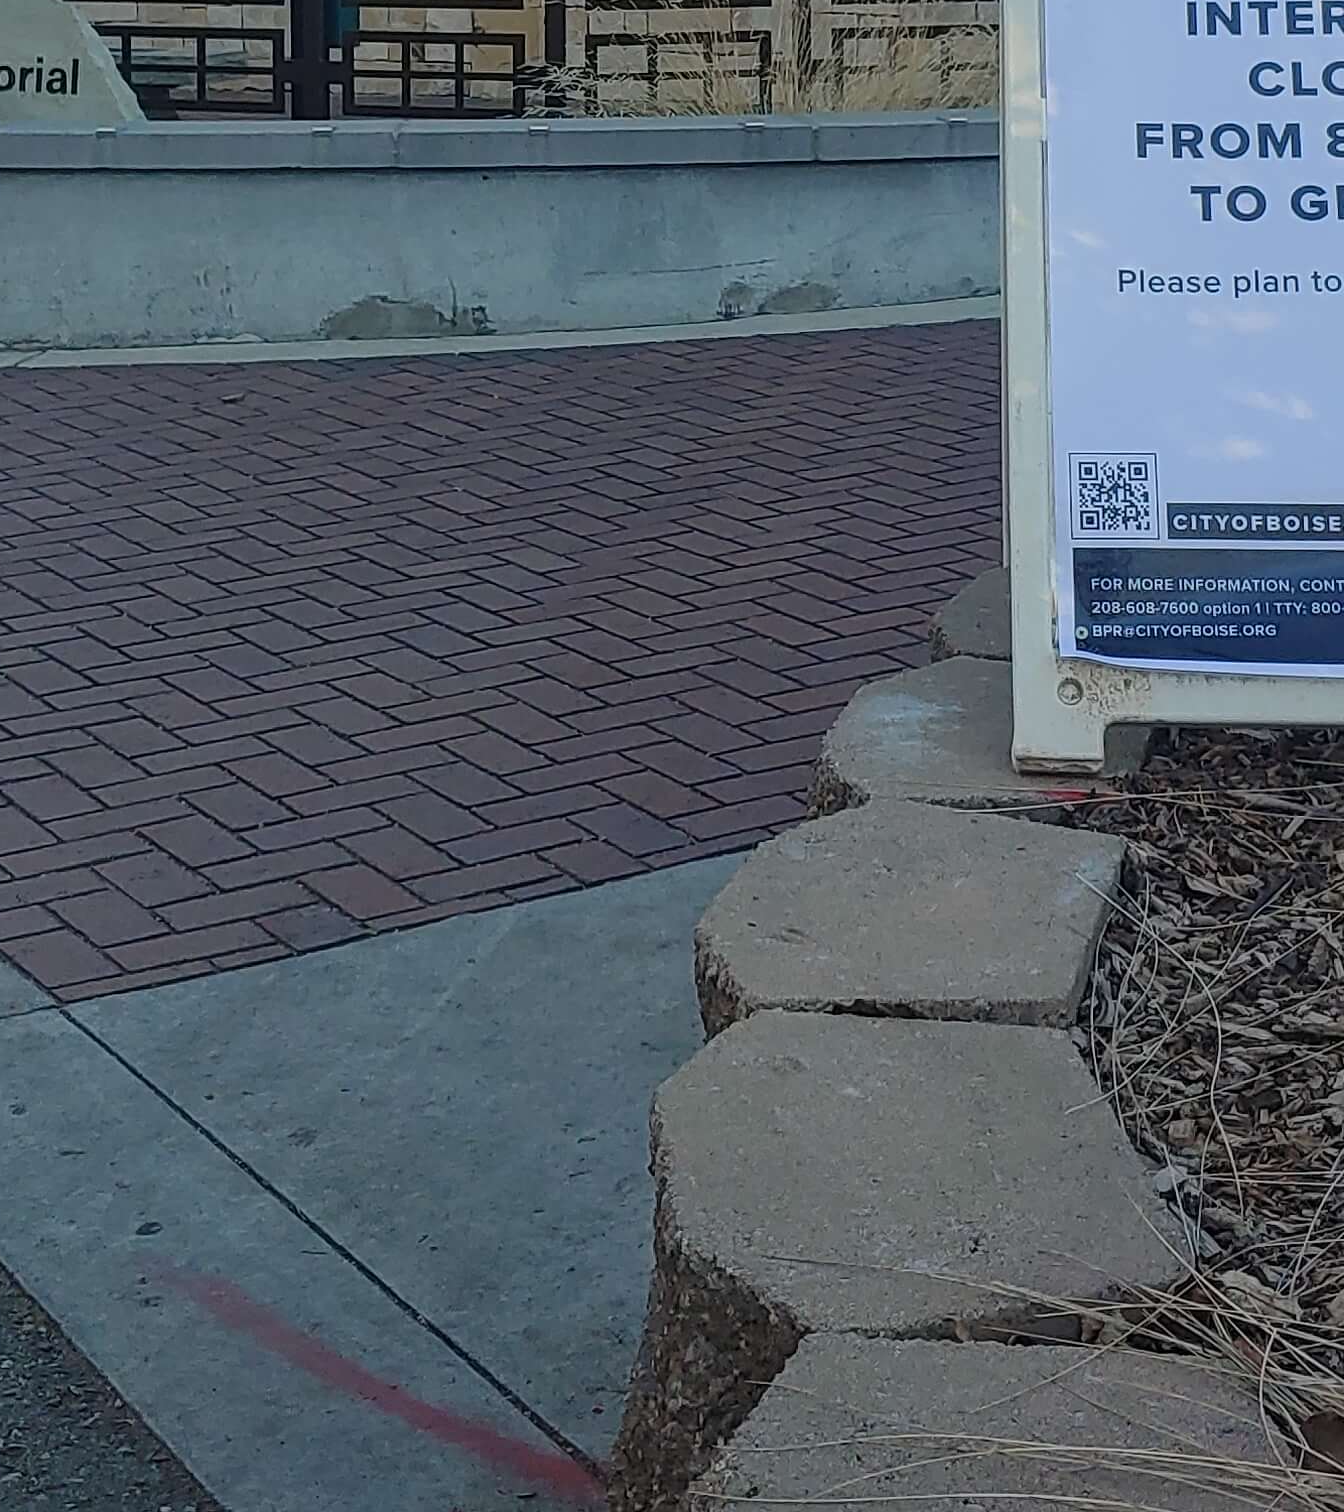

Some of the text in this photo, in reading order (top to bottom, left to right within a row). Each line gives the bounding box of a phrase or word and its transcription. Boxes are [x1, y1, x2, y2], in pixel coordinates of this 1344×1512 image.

[1136, 122, 1301, 159] FROM
[1191, 185, 1267, 222] TO
[1118, 269, 1220, 293] Please
[1234, 268, 1300, 299] plan
[1311, 270, 1342, 292] to
[1091, 579, 1123, 590] FOR
[1128, 579, 1173, 591] MORE
[1179, 579, 1295, 594] INFORMATION,
[1092, 602, 1198, 614] 208-608-7600
[1204, 603, 1249, 617] option
[1274, 603, 1306, 614] TTY:
[1093, 625, 1276, 638] BPR@CITYOFBOISE.ORG
